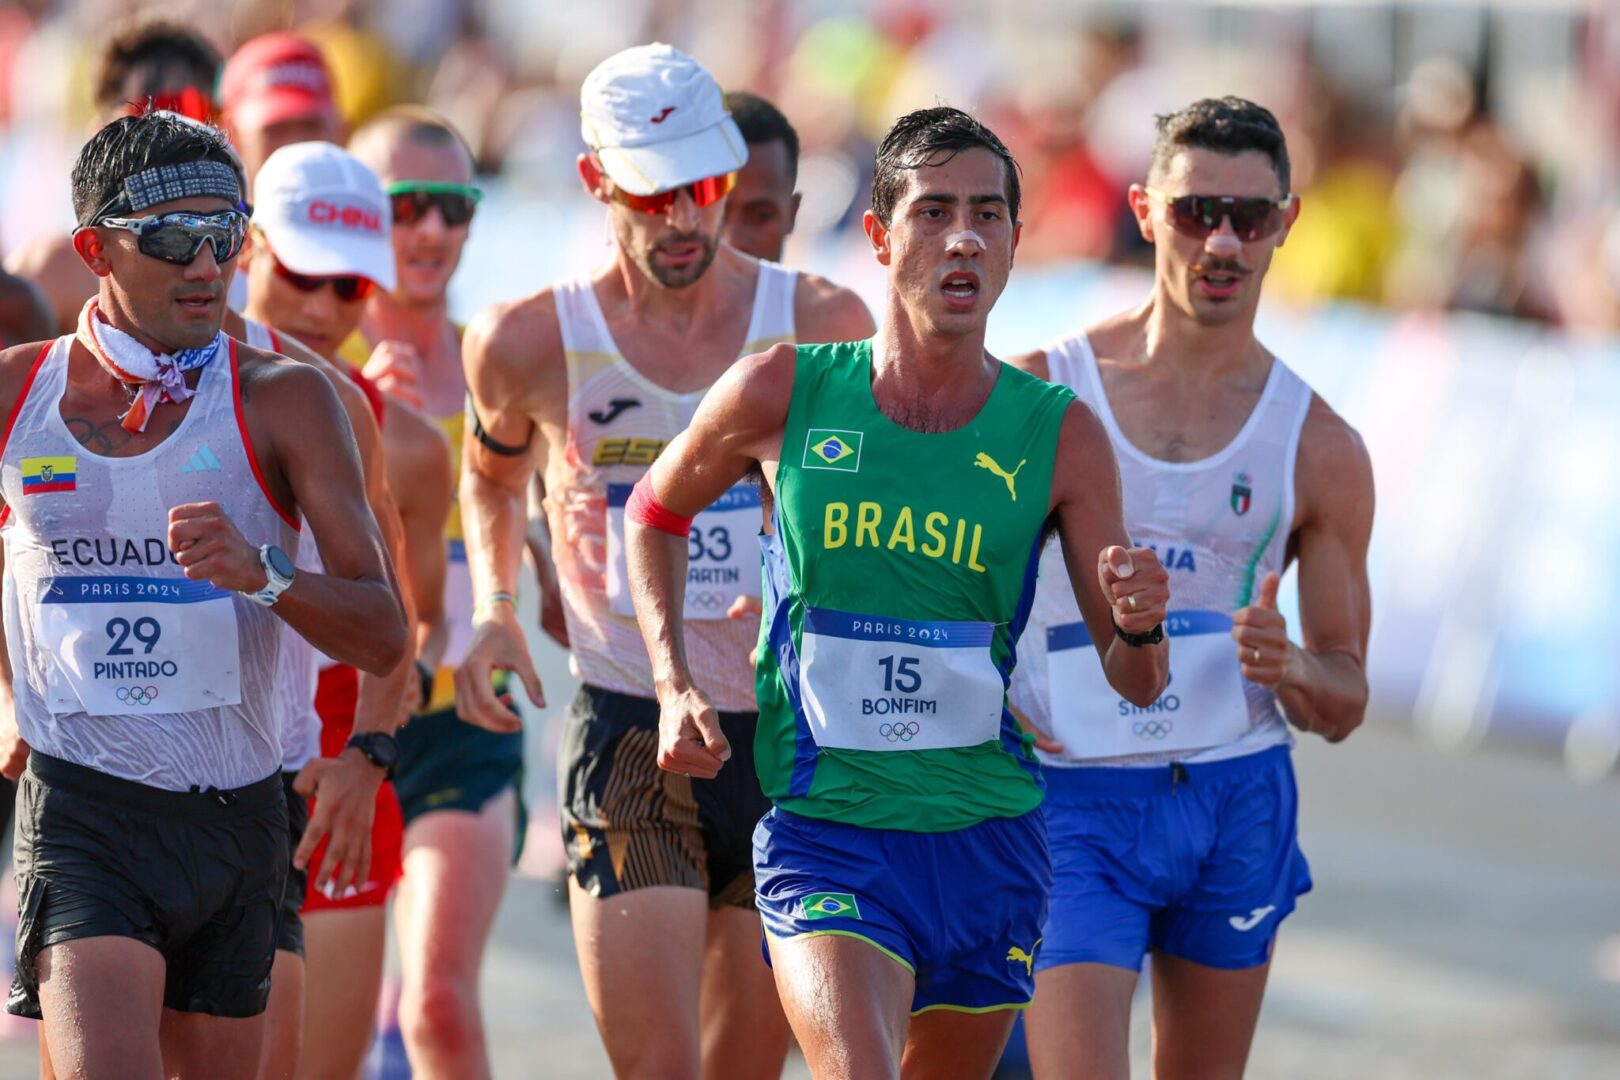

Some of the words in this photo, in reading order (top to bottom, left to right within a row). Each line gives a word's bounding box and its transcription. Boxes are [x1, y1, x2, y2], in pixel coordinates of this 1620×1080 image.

[823, 501, 987, 573] BRASIL
[687, 567, 739, 584] ARTIN
[137, 584, 180, 597] 2024
[105, 616, 162, 656] 29
[908, 627, 948, 641] 2024
[94, 660, 178, 680] PINTADO
[878, 655, 922, 694] 15
[862, 698, 937, 715] BONFIM
